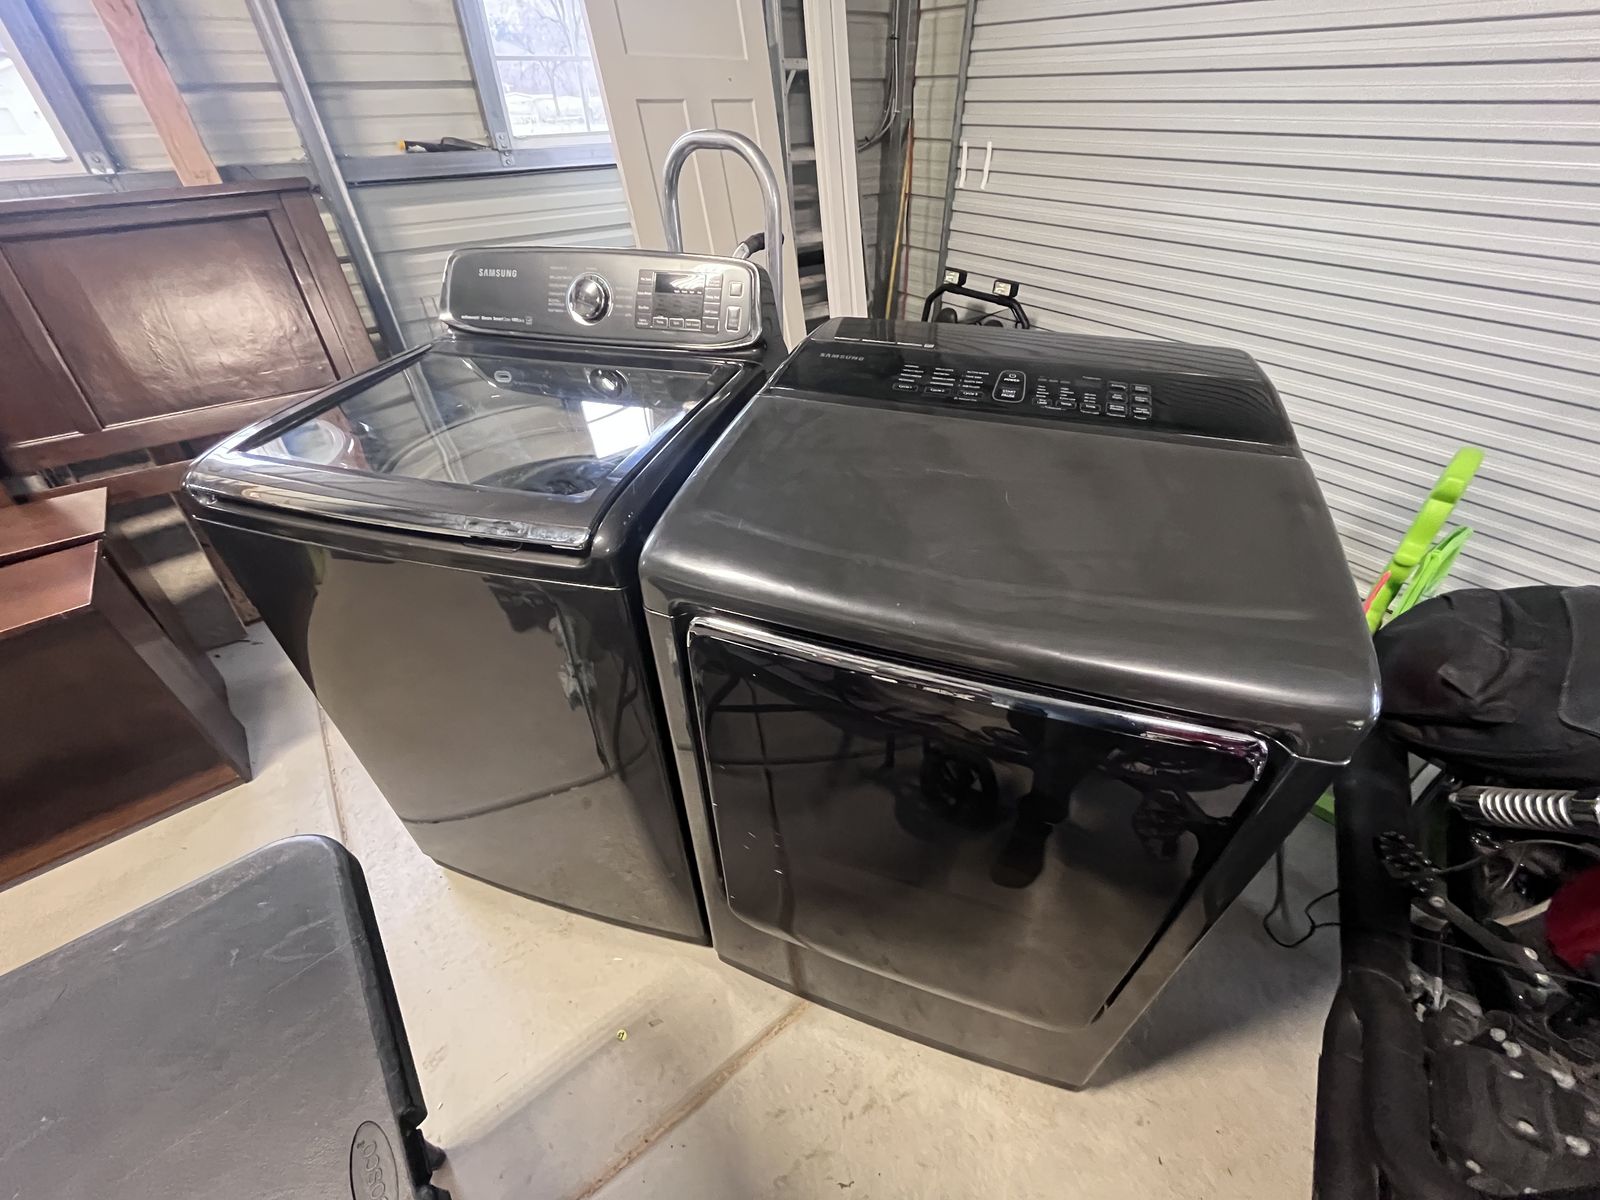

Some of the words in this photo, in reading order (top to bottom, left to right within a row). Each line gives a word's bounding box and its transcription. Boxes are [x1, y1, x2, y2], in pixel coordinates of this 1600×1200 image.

[478, 268, 518, 278] SAMSUNG
[820, 352, 864, 361] SAMSUNG
[362, 1140, 388, 1200] OSCO
